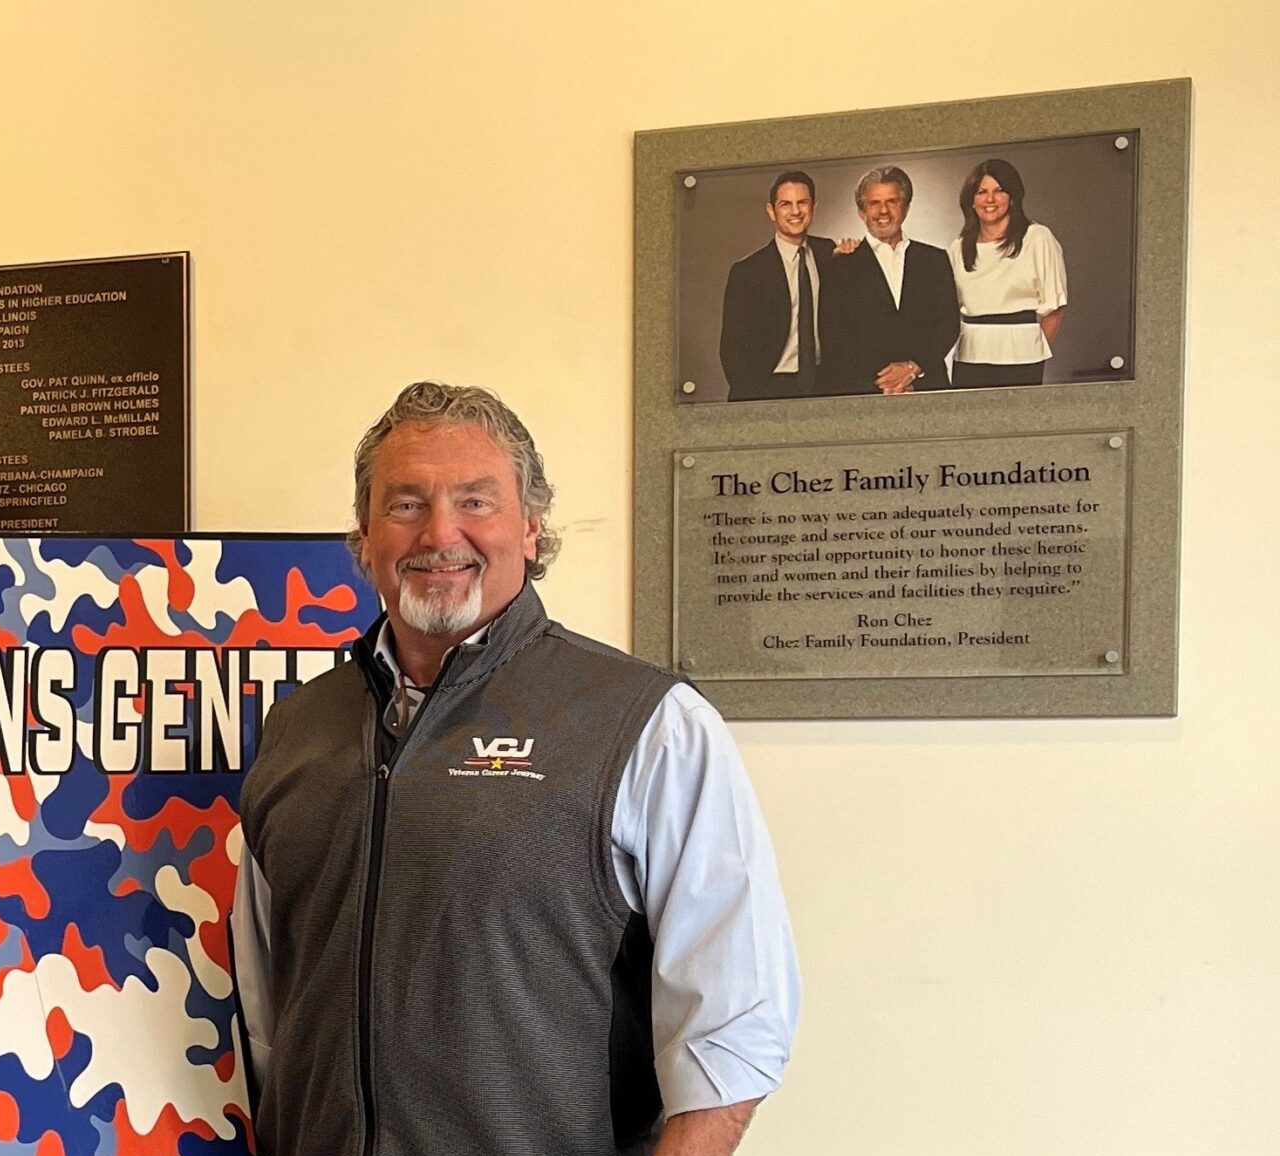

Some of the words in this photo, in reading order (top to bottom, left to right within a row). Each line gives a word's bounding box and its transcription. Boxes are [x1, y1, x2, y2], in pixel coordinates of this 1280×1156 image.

[8, 299, 19, 309] IN
[21, 295, 63, 308] HIGHER
[65, 291, 127, 305] EDUCATION
[2, 339, 25, 350] 2013
[21, 379, 46, 389] GOV.
[48, 376, 68, 387] PAT
[71, 375, 108, 386] QUINN,
[110, 376, 123, 384] ex
[125, 371, 159, 383] officio
[32, 390, 77, 401] PATRICK
[92, 385, 159, 398] FITZGERALD
[20, 403, 68, 415] PATRICIA
[70, 401, 111, 413] BROWN
[113, 398, 160, 410] HOLMES
[41, 416, 88, 428] EDWARD
[103, 412, 160, 425] McMILLAN
[48, 429, 93, 440] PAMELA
[109, 425, 160, 437] STROBEL
[712, 473, 762, 496] The
[770, 470, 834, 494] Chez
[842, 465, 930, 495] Family
[939, 461, 1091, 488] Foundation
[18, 482, 67, 494] CHICAGO
[761, 511, 773, 524] is
[777, 513, 796, 524] no
[801, 512, 830, 524] way
[836, 511, 857, 521] we
[861, 510, 888, 520] can
[892, 503, 975, 521] adequately
[979, 501, 1070, 518] compensate
[1076, 498, 1100, 513] for
[0, 518, 59, 529] PRESIDENT
[712, 531, 735, 546] the
[740, 533, 796, 546] courage
[801, 528, 828, 543] and
[833, 529, 885, 541] service
[890, 525, 906, 540] of
[910, 528, 937, 539] our
[942, 521, 1012, 537] wounded
[1018, 522, 1088, 535] veterans.
[713, 551, 736, 565] It's
[741, 554, 766, 564] our
[771, 548, 820, 565] special
[825, 548, 914, 564] opportunity
[920, 546, 935, 558] to
[940, 543, 986, 558] honor
[991, 542, 1031, 556] these
[1036, 540, 1086, 555] heroic
[717, 573, 748, 584] men
[752, 568, 779, 583] and
[784, 570, 837, 582] women
[841, 566, 869, 580] and
[874, 565, 911, 579] their
[916, 563, 974, 578] families
[980, 562, 998, 577] by
[1003, 561, 1061, 577] helping
[1066, 563, 1082, 574] to
[717, 589, 772, 606] provide
[777, 588, 801, 601] the
[804, 588, 864, 601] services
[868, 585, 896, 599] and
[901, 584, 965, 598] facilities
[970, 582, 1003, 598] they
[857, 613, 889, 628] Ron
[893, 613, 933, 627] Chez
[762, 635, 800, 649] Chez
[805, 634, 855, 650] Family
[860, 632, 952, 648] Foundation,
[957, 630, 1030, 646] President
[481, 768, 509, 777] Career
[510, 768, 546, 781] Journey
